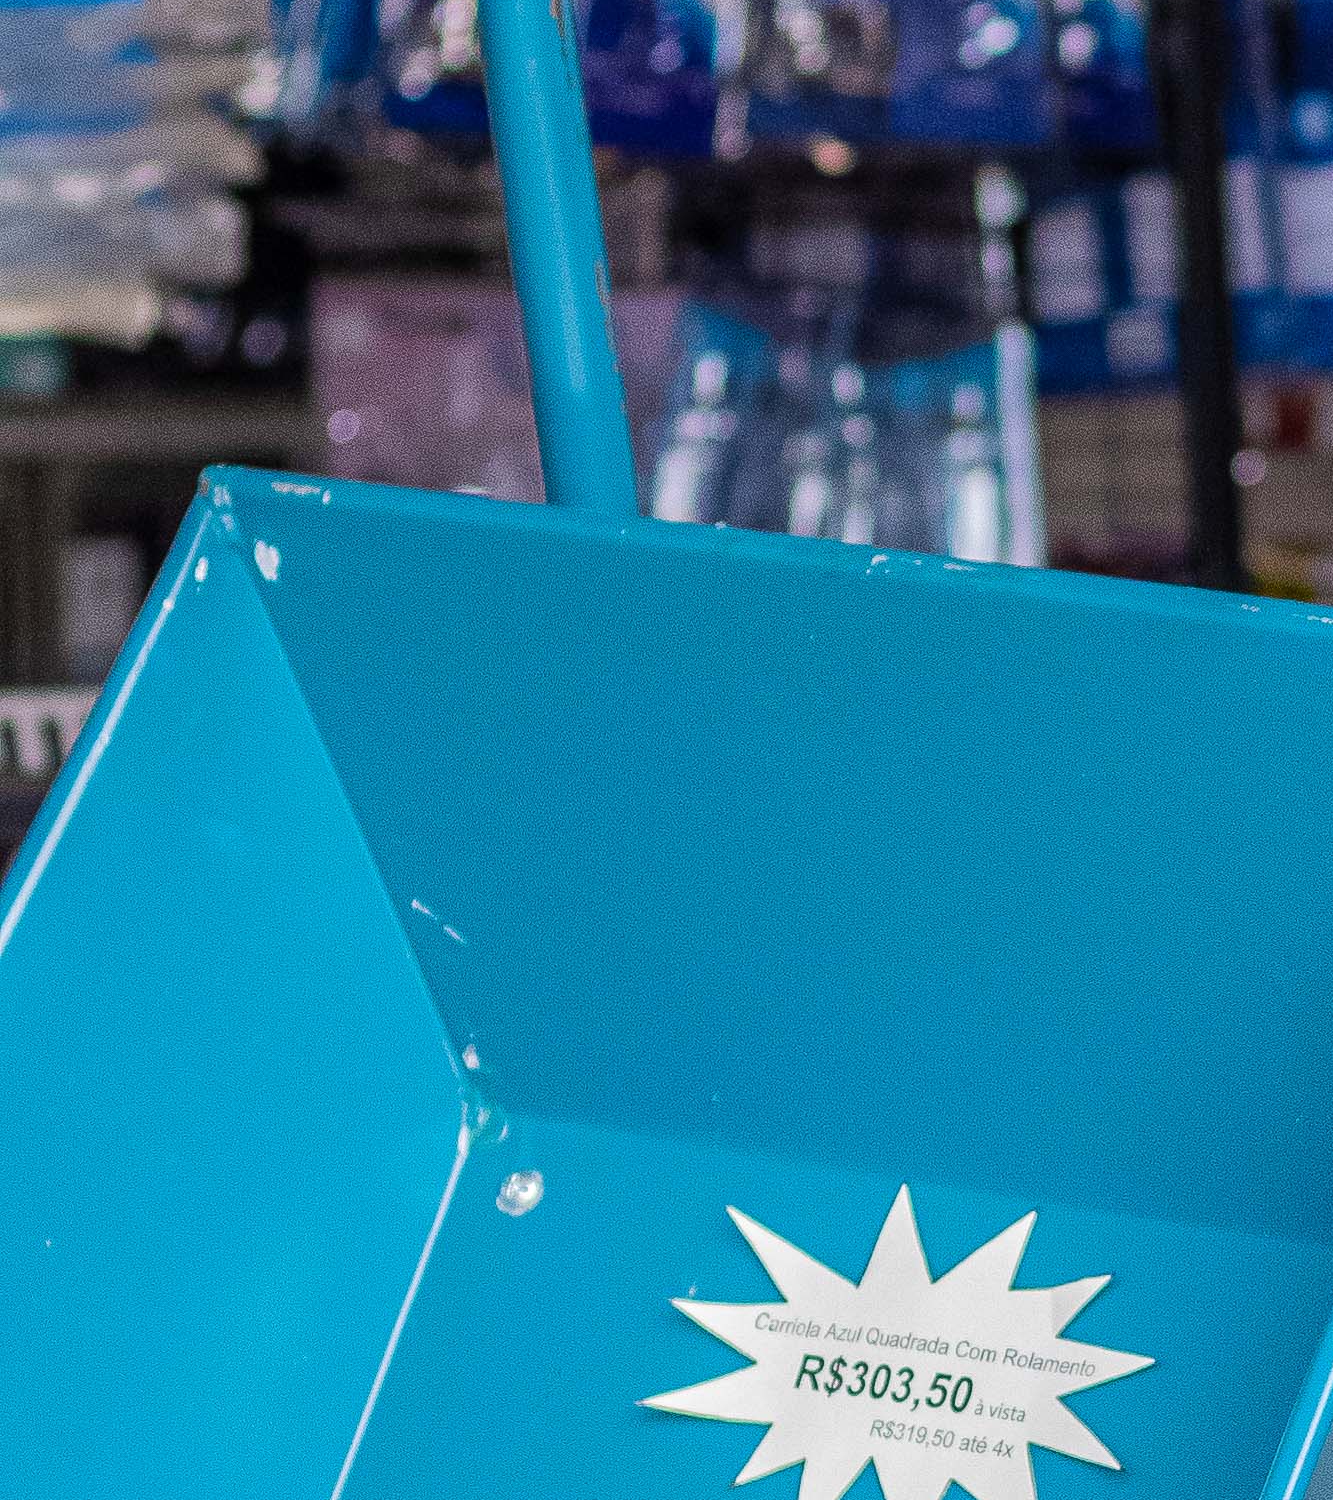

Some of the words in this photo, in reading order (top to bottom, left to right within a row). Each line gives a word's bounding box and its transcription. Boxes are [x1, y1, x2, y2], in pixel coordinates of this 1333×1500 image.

[754, 1312, 820, 1339] Carriola
[824, 1322, 861, 1343] Azul
[866, 1327, 949, 1355] Quadrada
[955, 1341, 996, 1363] Com
[1002, 1348, 1096, 1377] Rolamento
[794, 1353, 974, 1412] R$303,50
[988, 1403, 1027, 1423] vista
[868, 1419, 955, 1449] R$319,50
[958, 1433, 988, 1455] até
[991, 1438, 1015, 1459] 4x
